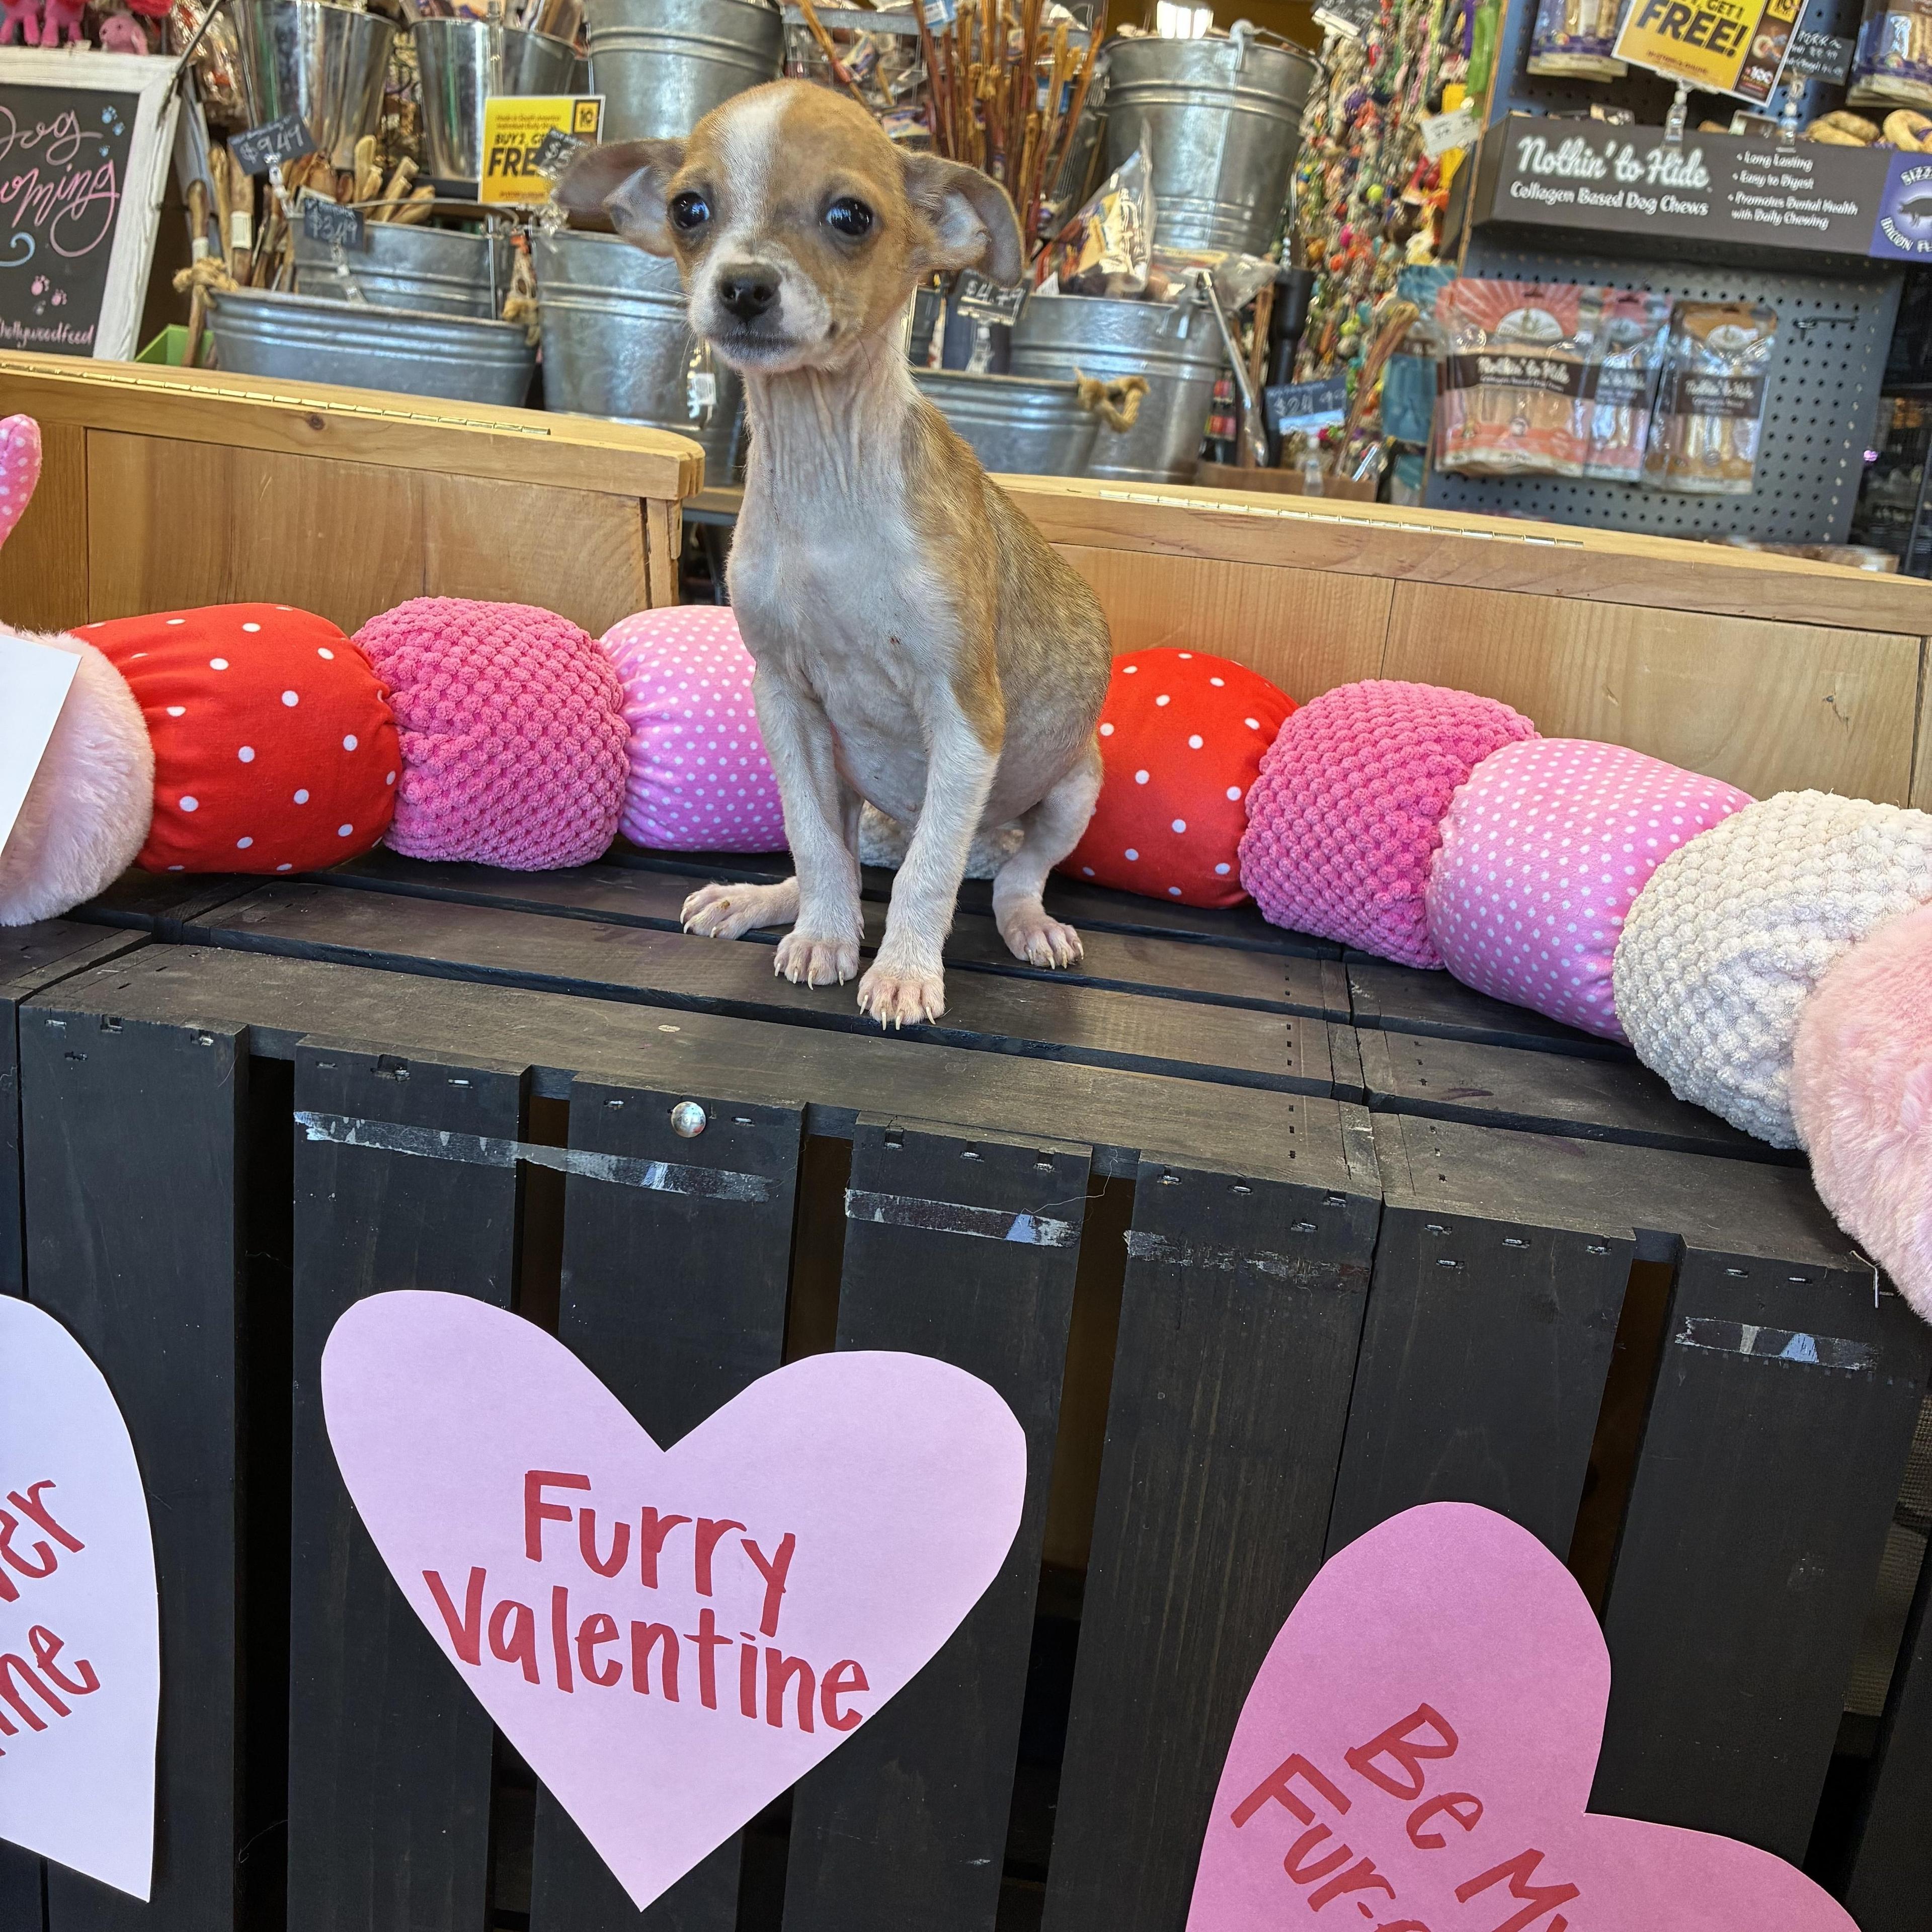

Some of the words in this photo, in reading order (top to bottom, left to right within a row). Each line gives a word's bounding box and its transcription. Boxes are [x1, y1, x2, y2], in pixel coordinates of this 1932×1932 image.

[1637, 1, 1748, 58] FREE!
[1615, 143, 1645, 182] to
[1744, 150, 1772, 169] Long
[1773, 153, 1813, 173] Lasting
[1510, 180, 1574, 205] Collagen
[1577, 186, 1623, 207] Based
[1626, 190, 1657, 215] Dog
[1660, 194, 1709, 216] Chews
[1739, 170, 1766, 188] Easy
[1767, 174, 1780, 186] to
[1780, 173, 1814, 191] Digest
[1731, 208, 1753, 220] with
[1754, 208, 1783, 226] Daily
[1783, 210, 1829, 231] Chewing
[1735, 191, 1785, 208] Promotes
[1786, 195, 1822, 212] Dental
[1822, 198, 1859, 215] Health
[524, 1470, 795, 1637] Furry
[422, 1566, 870, 1734] Valentine
[1344, 1702, 1484, 1849] Be
[1455, 1848, 1581, 1932] M
